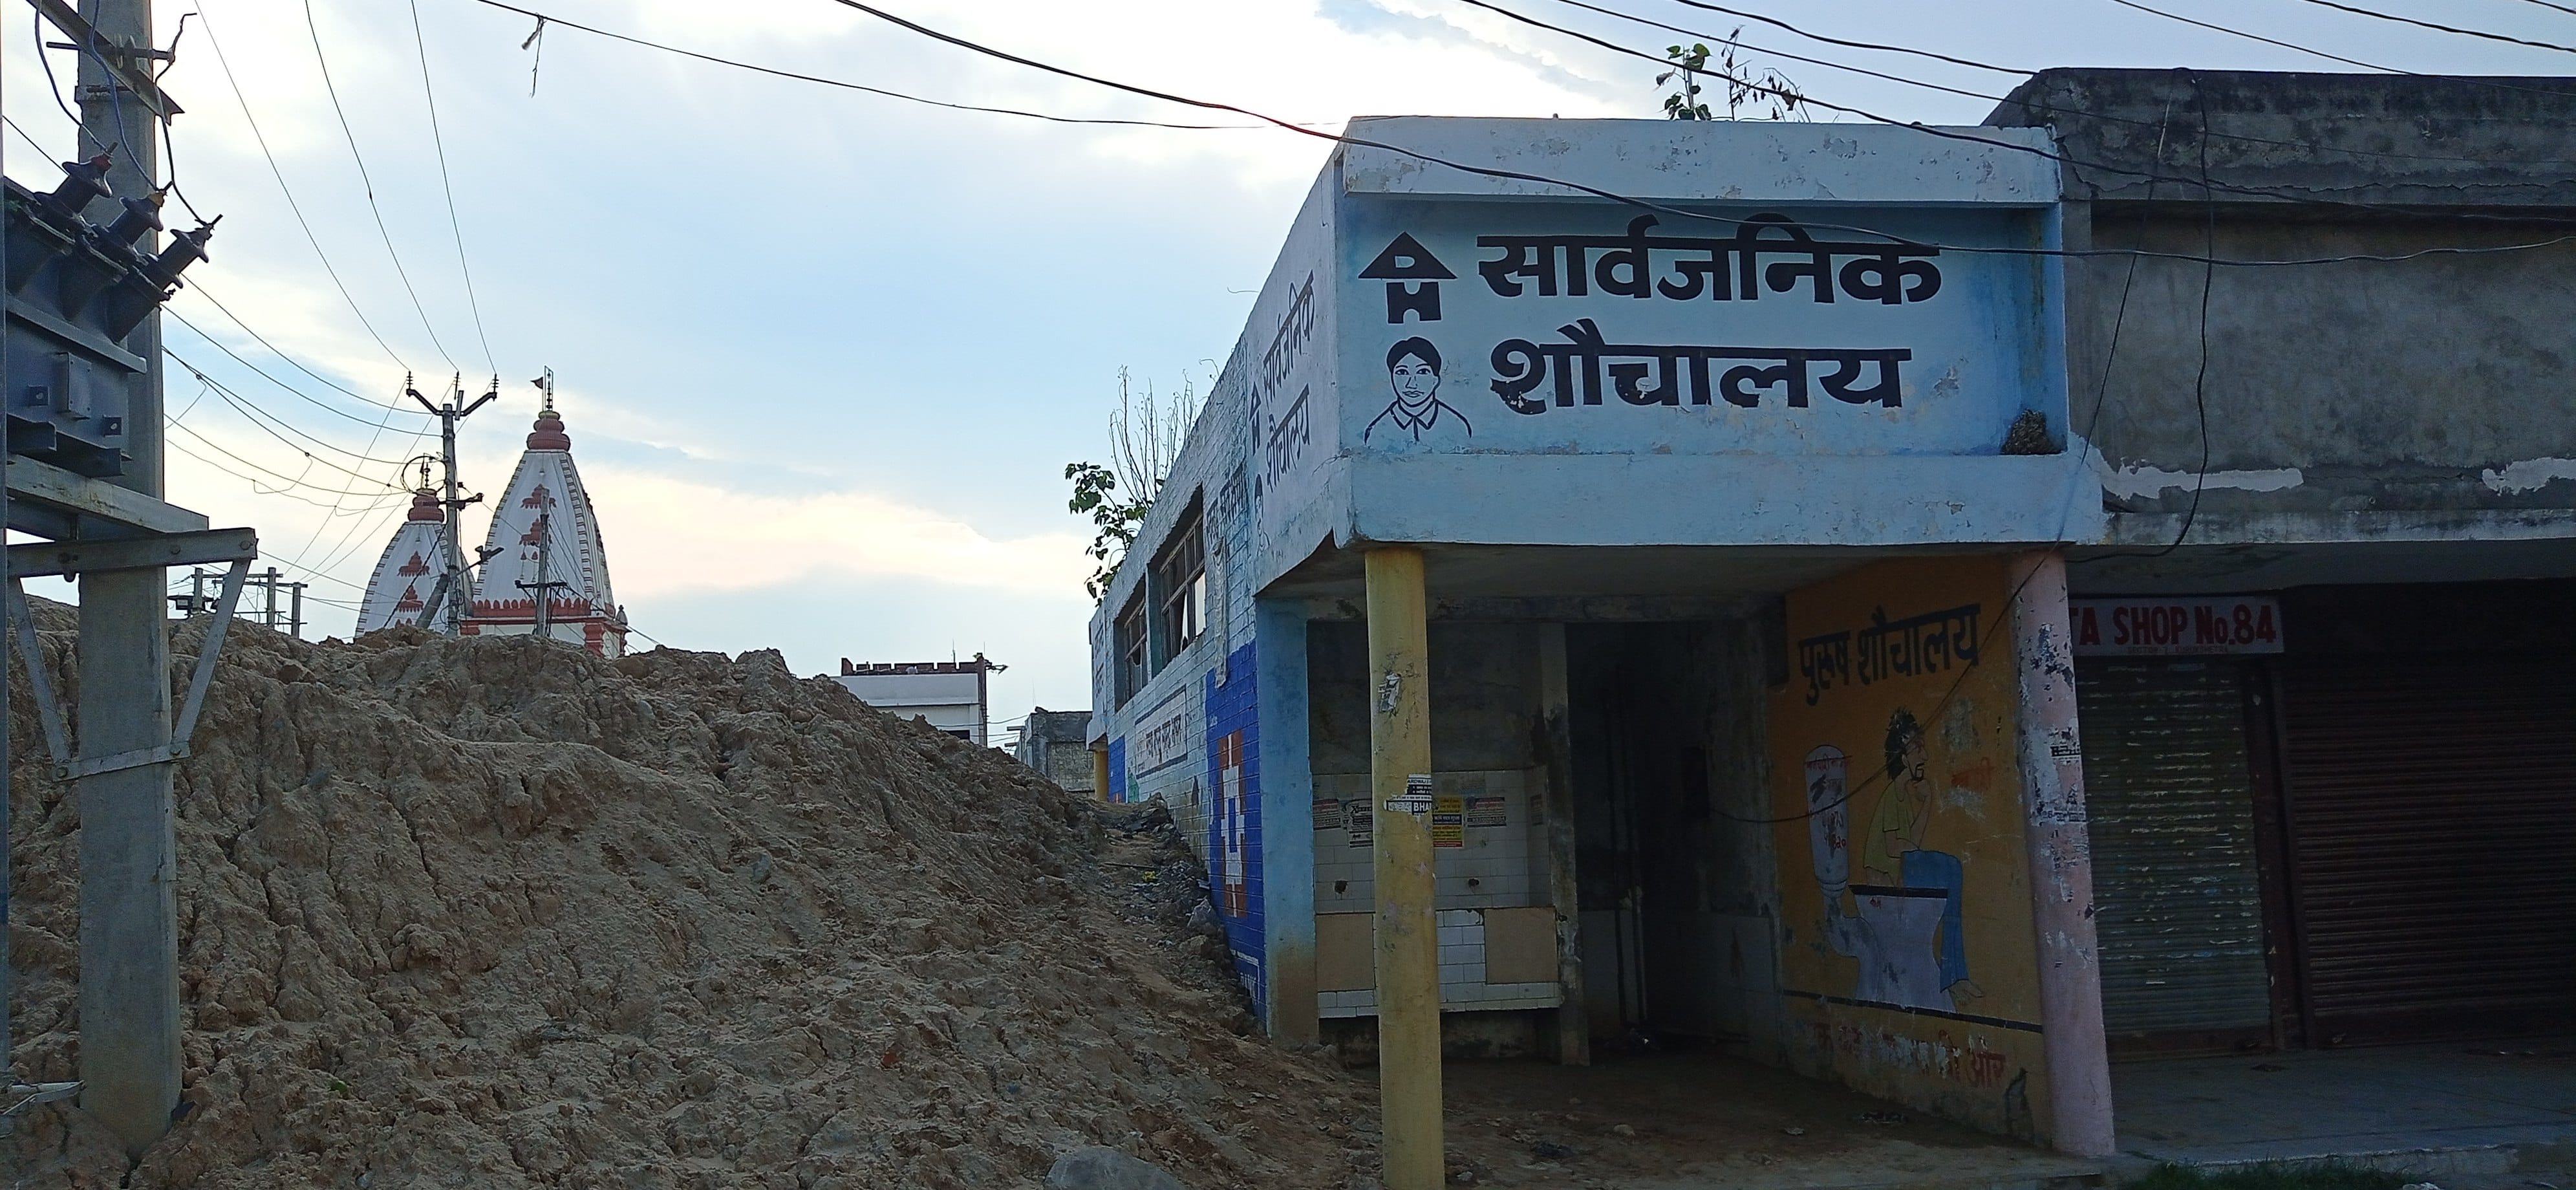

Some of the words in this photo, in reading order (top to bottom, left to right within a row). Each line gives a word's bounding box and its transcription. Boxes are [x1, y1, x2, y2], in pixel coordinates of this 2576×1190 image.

[1476, 213, 1942, 306] सार्वजनिक
[1263, 269, 1315, 410] सार्वजनिक
[1490, 318, 1913, 415] शौचालय
[1266, 383, 1310, 493] शौचालय
[1857, 605, 1980, 686] शौचालय
[2112, 605, 2188, 645] SHOP
